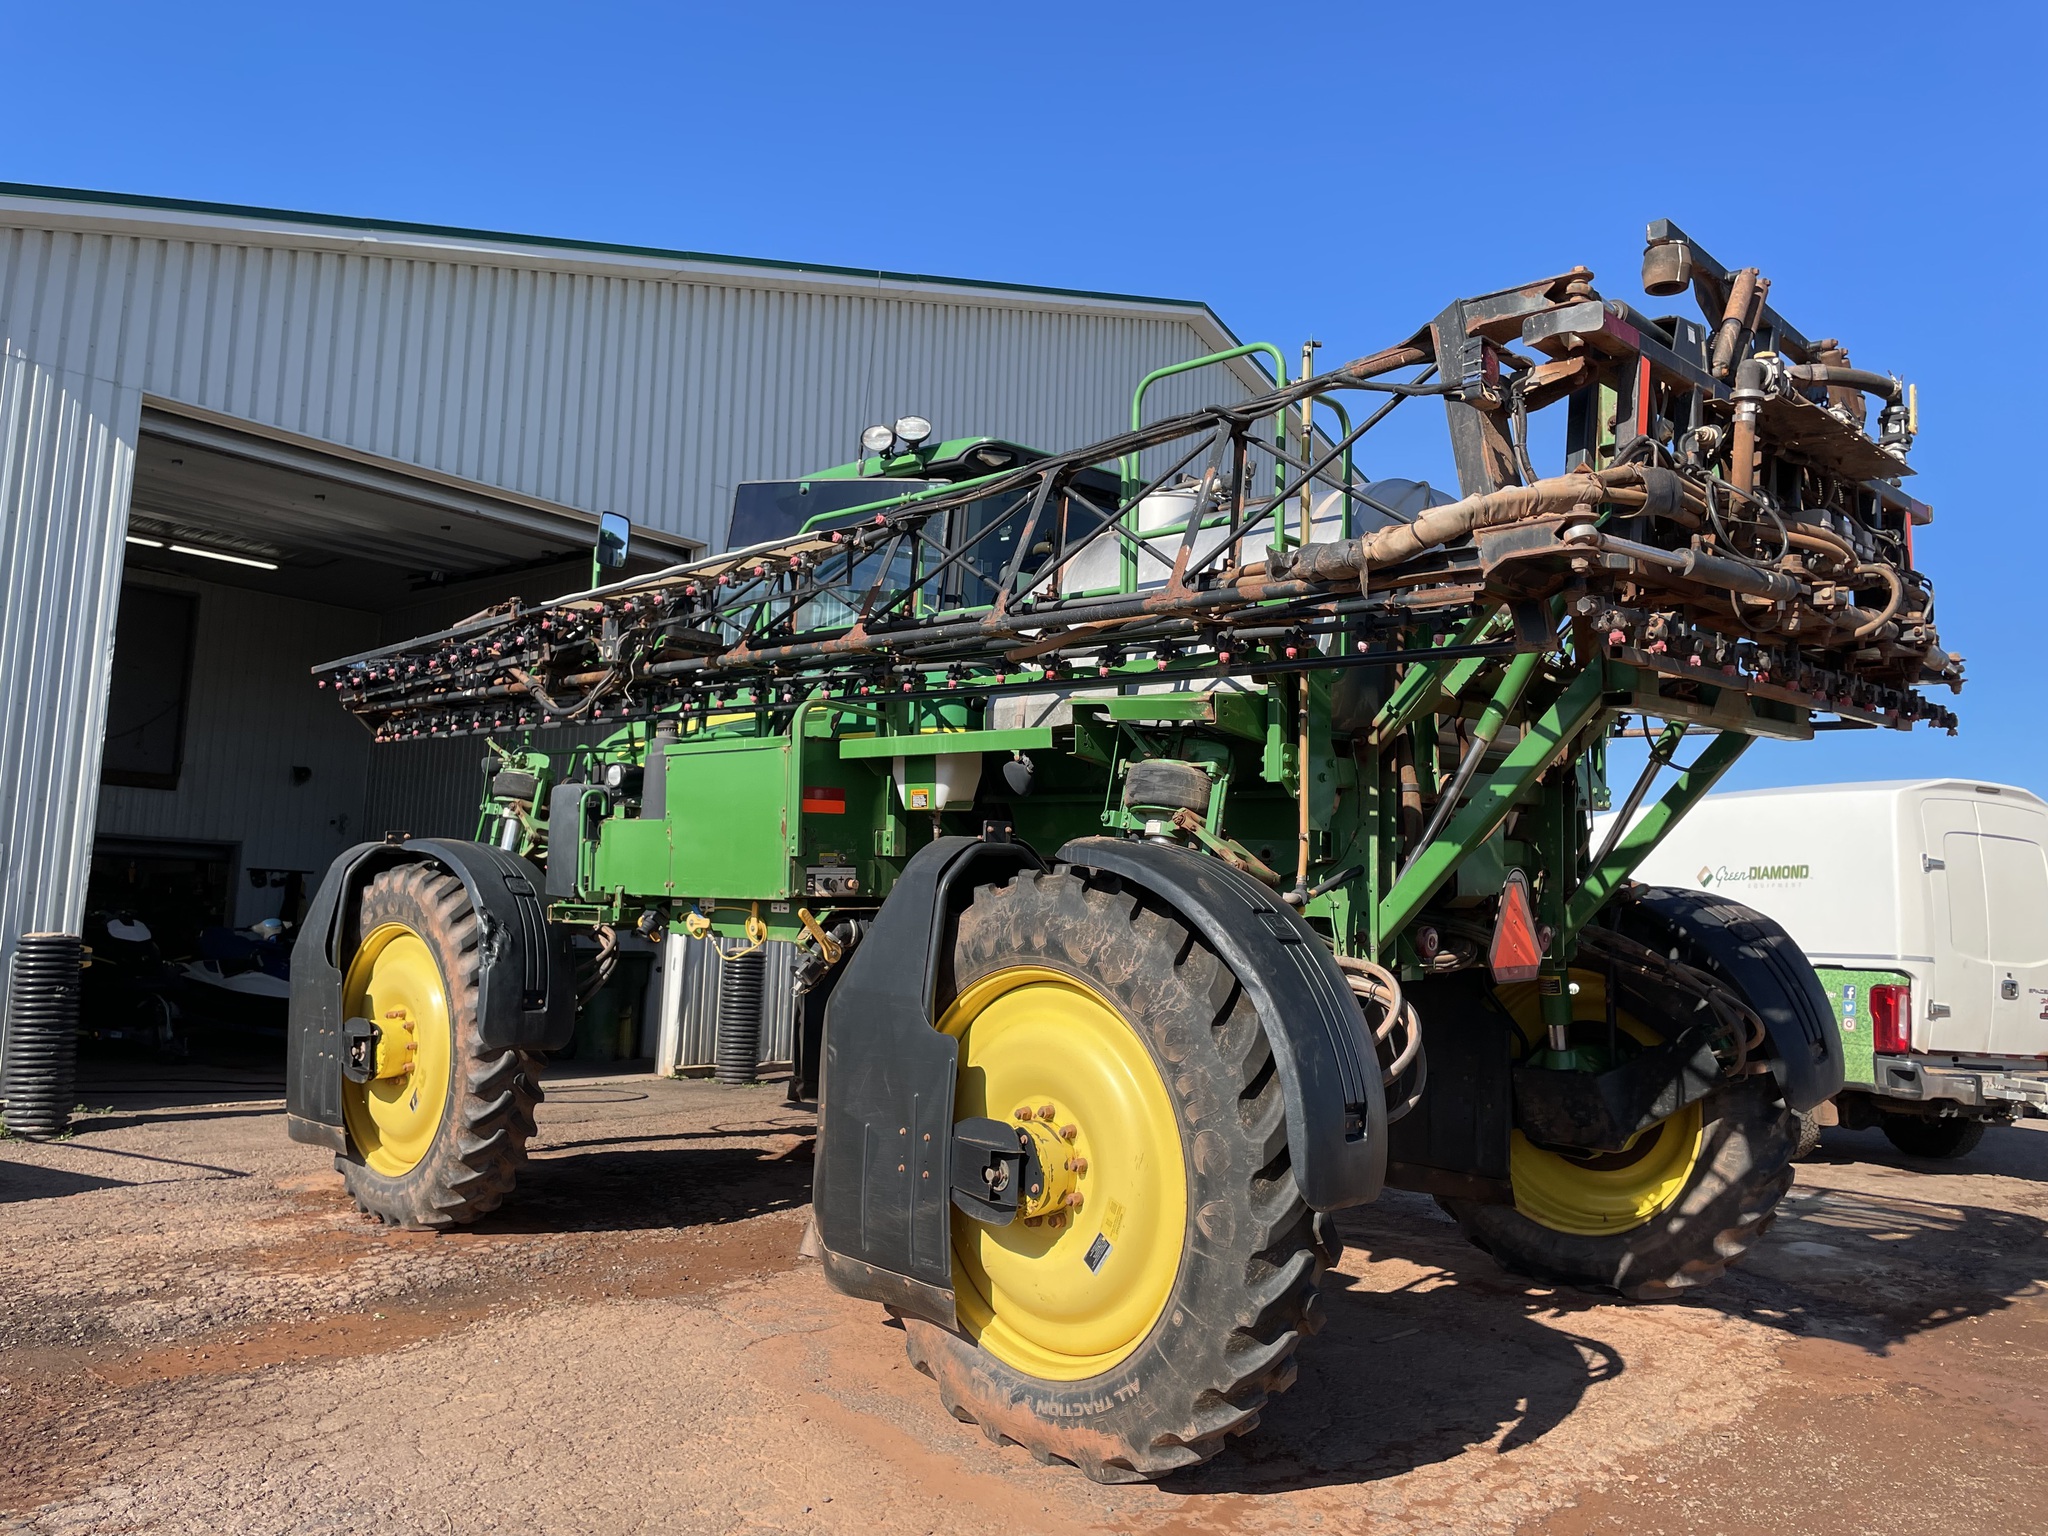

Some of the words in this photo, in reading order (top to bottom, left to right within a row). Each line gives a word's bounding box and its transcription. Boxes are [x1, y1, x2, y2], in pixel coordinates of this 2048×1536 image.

[1715, 865, 1750, 888] Green
[1749, 864, 1809, 880] DIAMOND
[1113, 1377, 1141, 1402] ALL
[1036, 1395, 1115, 1417] TRACTION
